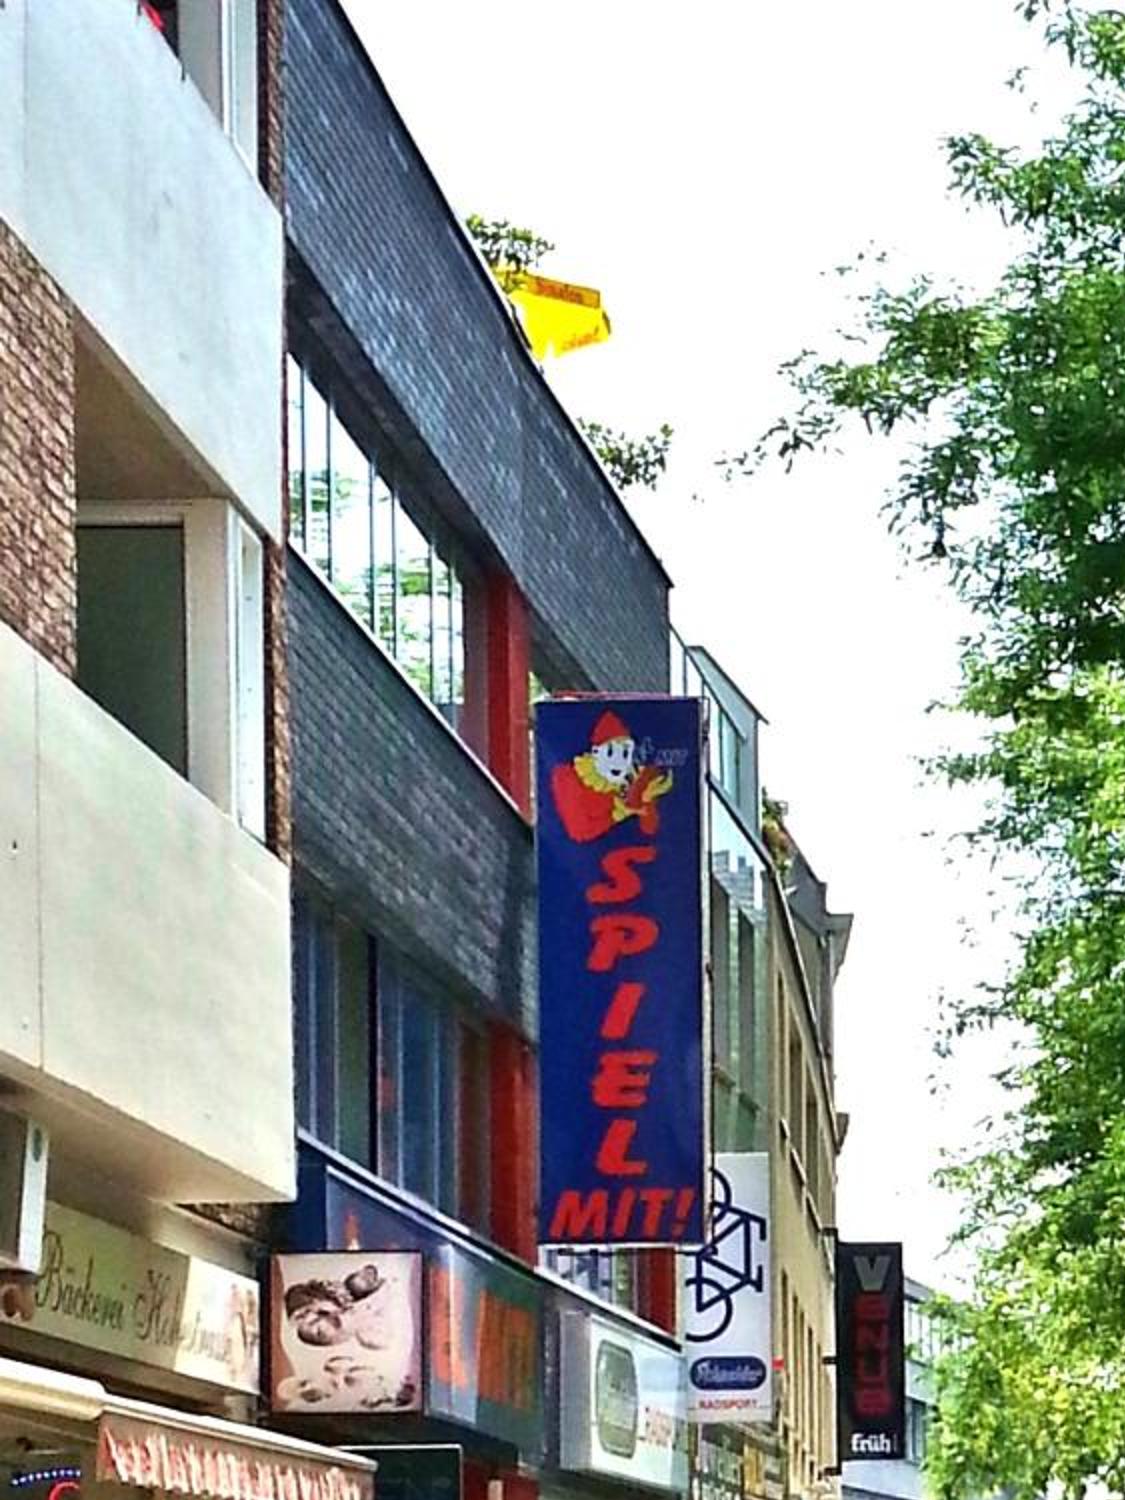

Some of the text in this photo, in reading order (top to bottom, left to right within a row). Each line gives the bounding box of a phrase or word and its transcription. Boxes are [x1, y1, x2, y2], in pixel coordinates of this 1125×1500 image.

[586, 848, 659, 1175] SPIEL
[550, 1190, 694, 1237] MIT!
[851, 1433, 891, 1453] früh
